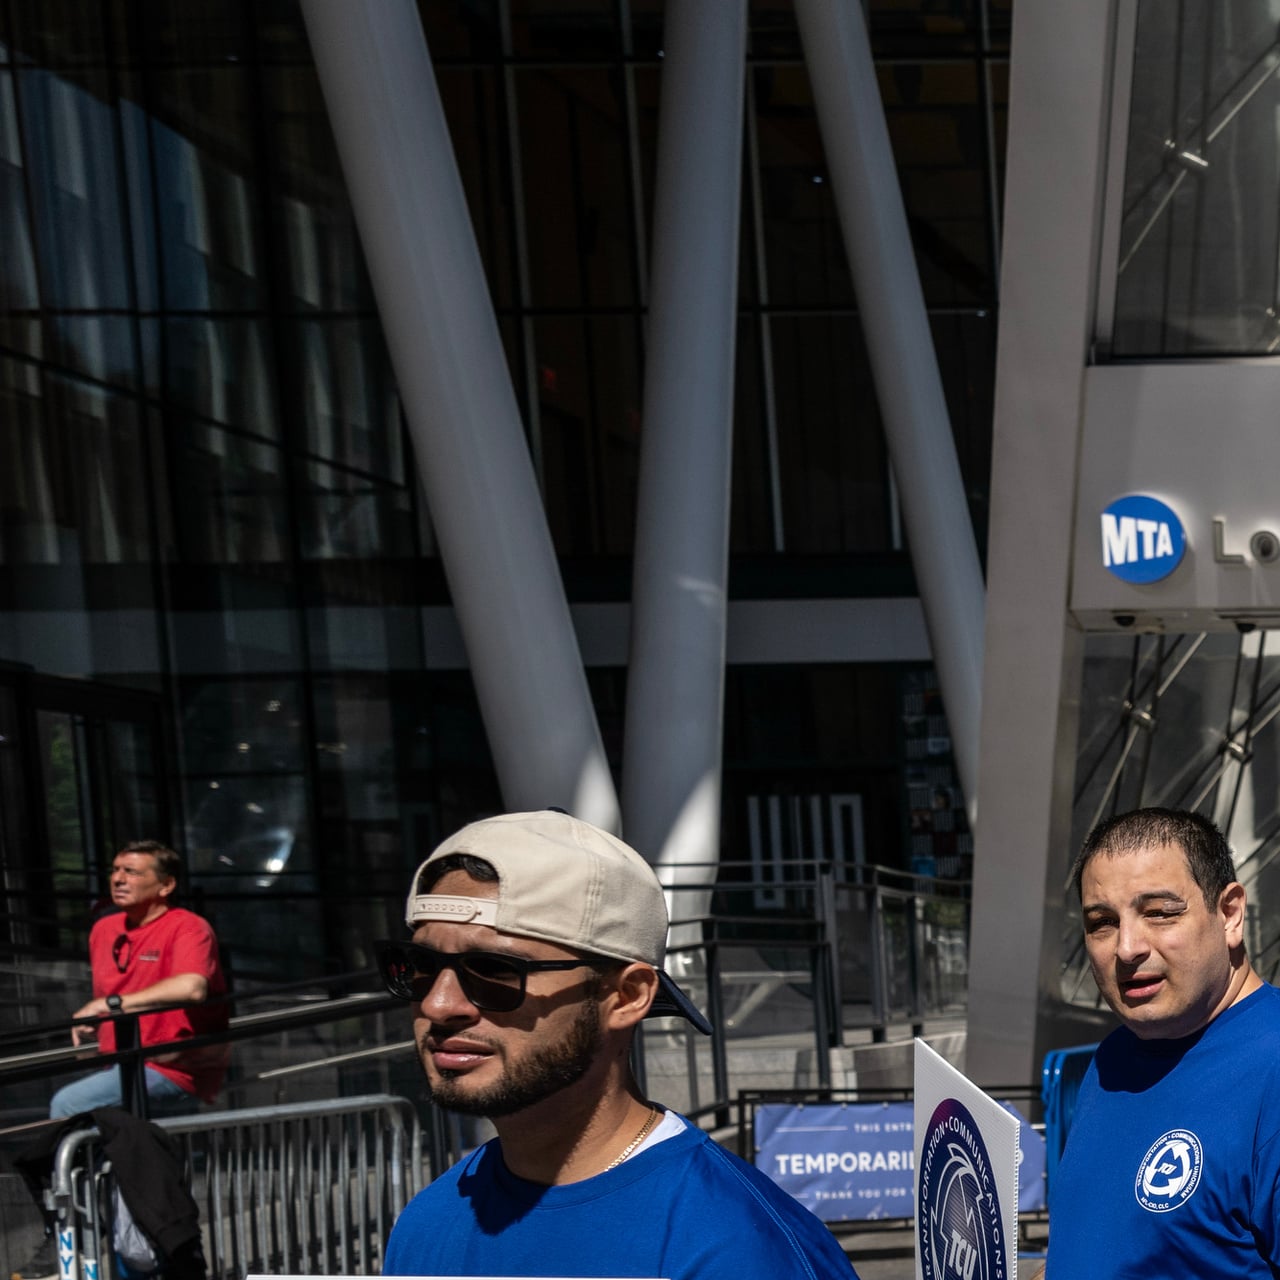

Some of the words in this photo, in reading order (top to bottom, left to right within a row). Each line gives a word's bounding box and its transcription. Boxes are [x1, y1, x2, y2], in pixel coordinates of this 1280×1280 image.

[1101, 512, 1175, 568] MTA
[854, 1123, 881, 1133] THIS
[775, 1151, 914, 1175] TEMPORARIL
[814, 1190, 851, 1201] THANK
[857, 1188, 881, 1199] YOU
[885, 1187, 907, 1197] FOR
[949, 1116, 1004, 1280] COMMUNICATIONS
